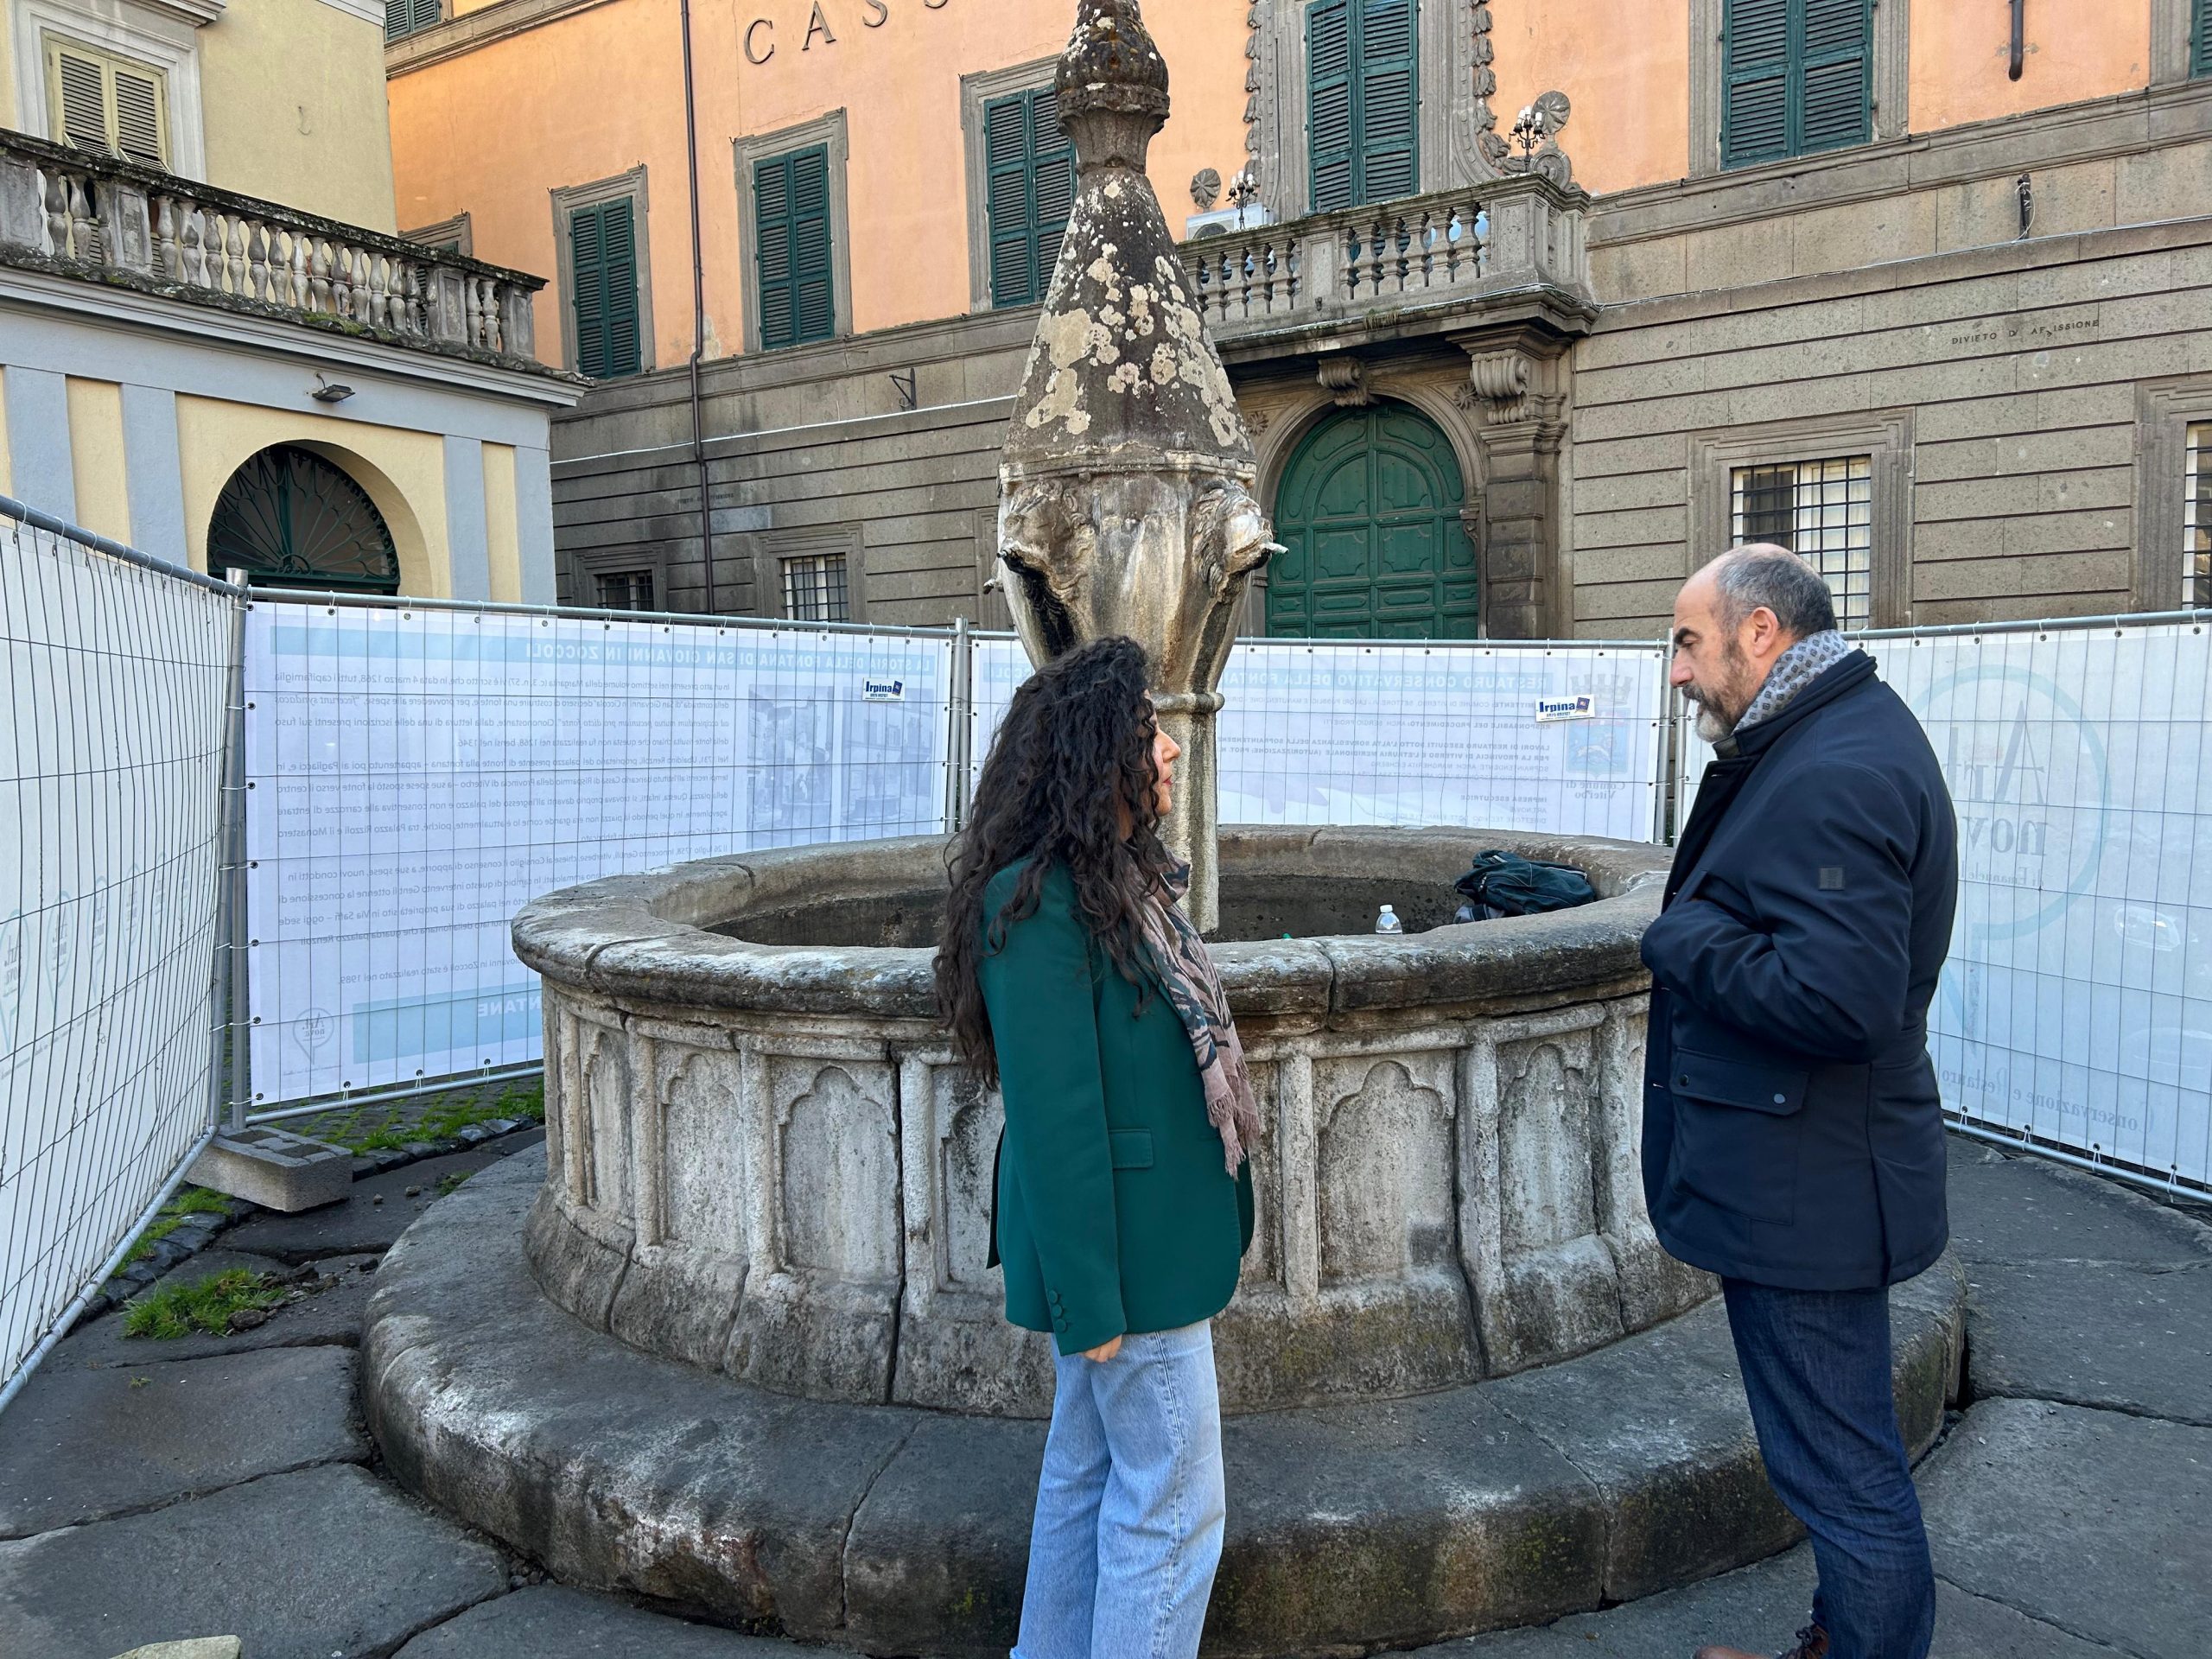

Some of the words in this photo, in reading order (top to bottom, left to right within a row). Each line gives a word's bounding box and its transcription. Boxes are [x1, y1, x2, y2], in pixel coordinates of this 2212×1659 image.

[743, 0, 949, 64] CAS
[1952, 332, 1997, 344] DIVIETO
[866, 681, 892, 693] Irpina
[1539, 702, 1575, 712] Irpina
